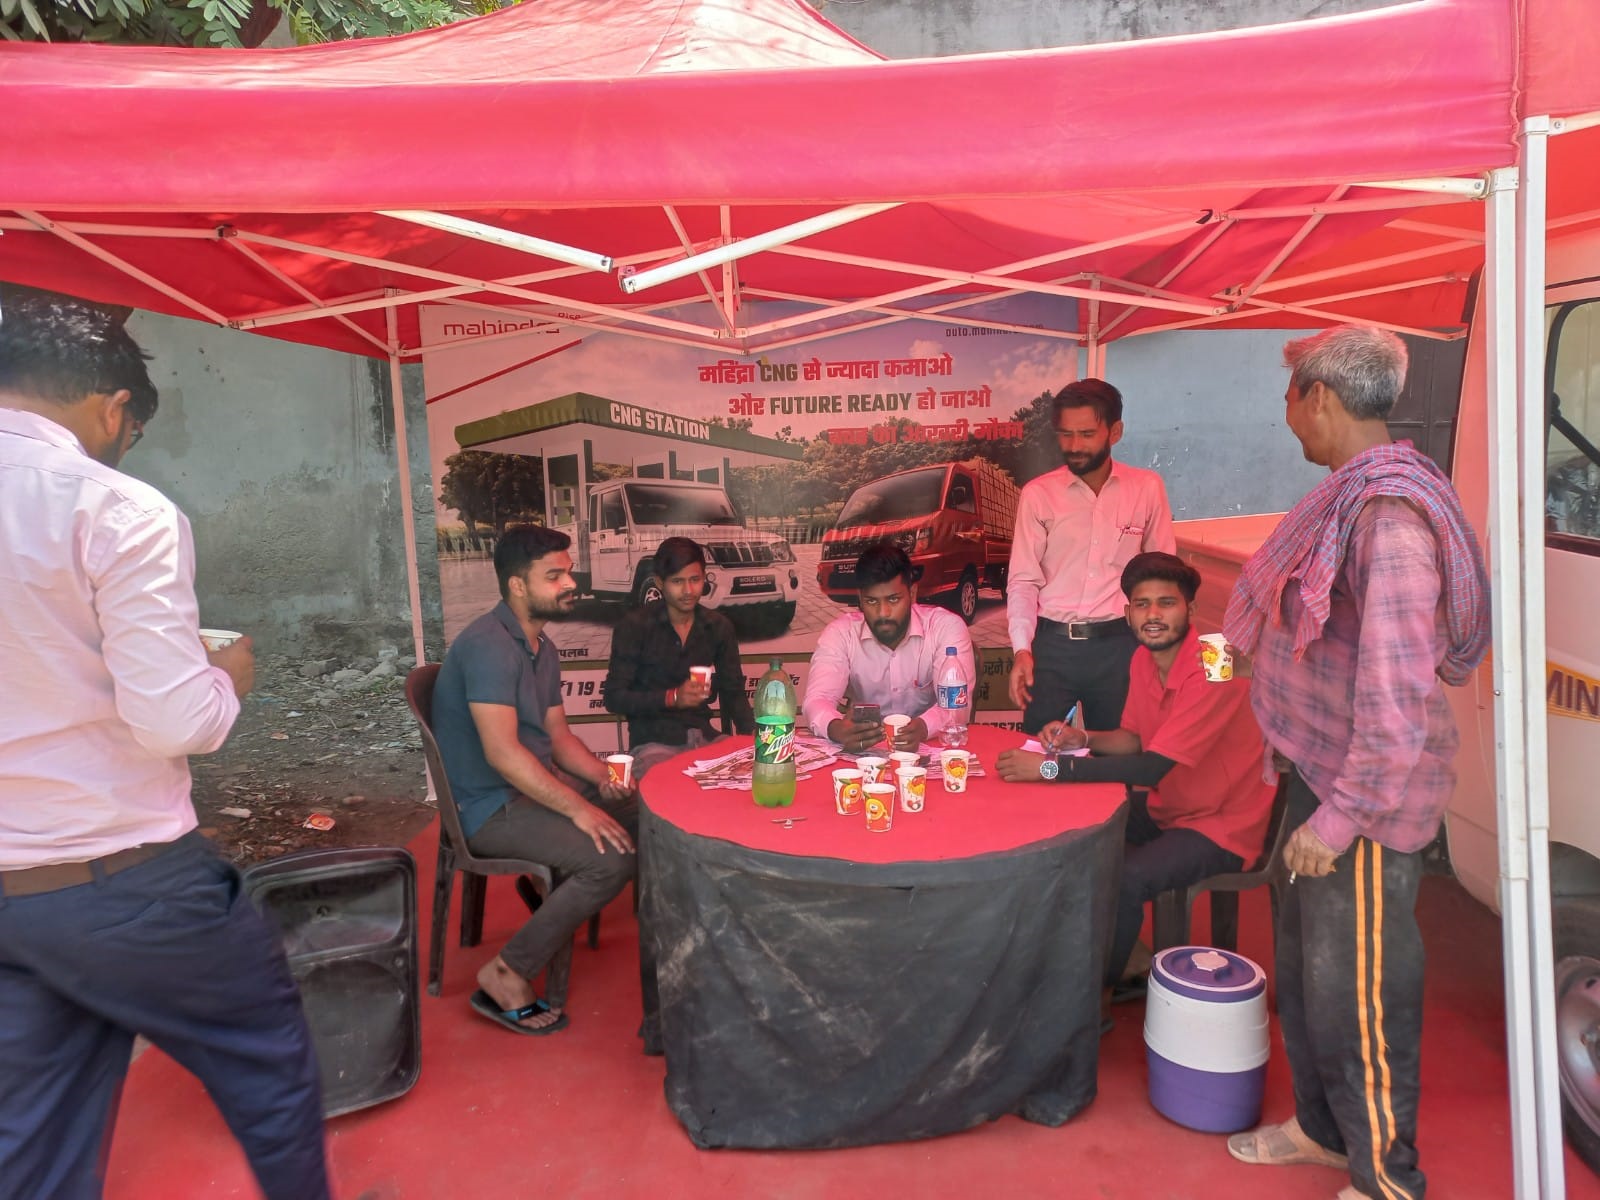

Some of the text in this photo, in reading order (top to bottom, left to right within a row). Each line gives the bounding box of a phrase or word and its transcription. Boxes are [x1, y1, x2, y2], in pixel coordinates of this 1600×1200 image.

[443, 319, 560, 336] mahind
[760, 363, 798, 382] CNG
[803, 357, 822, 380] से
[825, 360, 880, 379] ज्यादा
[884, 352, 953, 377] कमाओ
[729, 385, 992, 415] और FUTURE READY हो जाओ
[610, 402, 710, 440] CNG STATION
[558, 648, 589, 657] पलब्ध
[577, 681, 595, 696] 19
